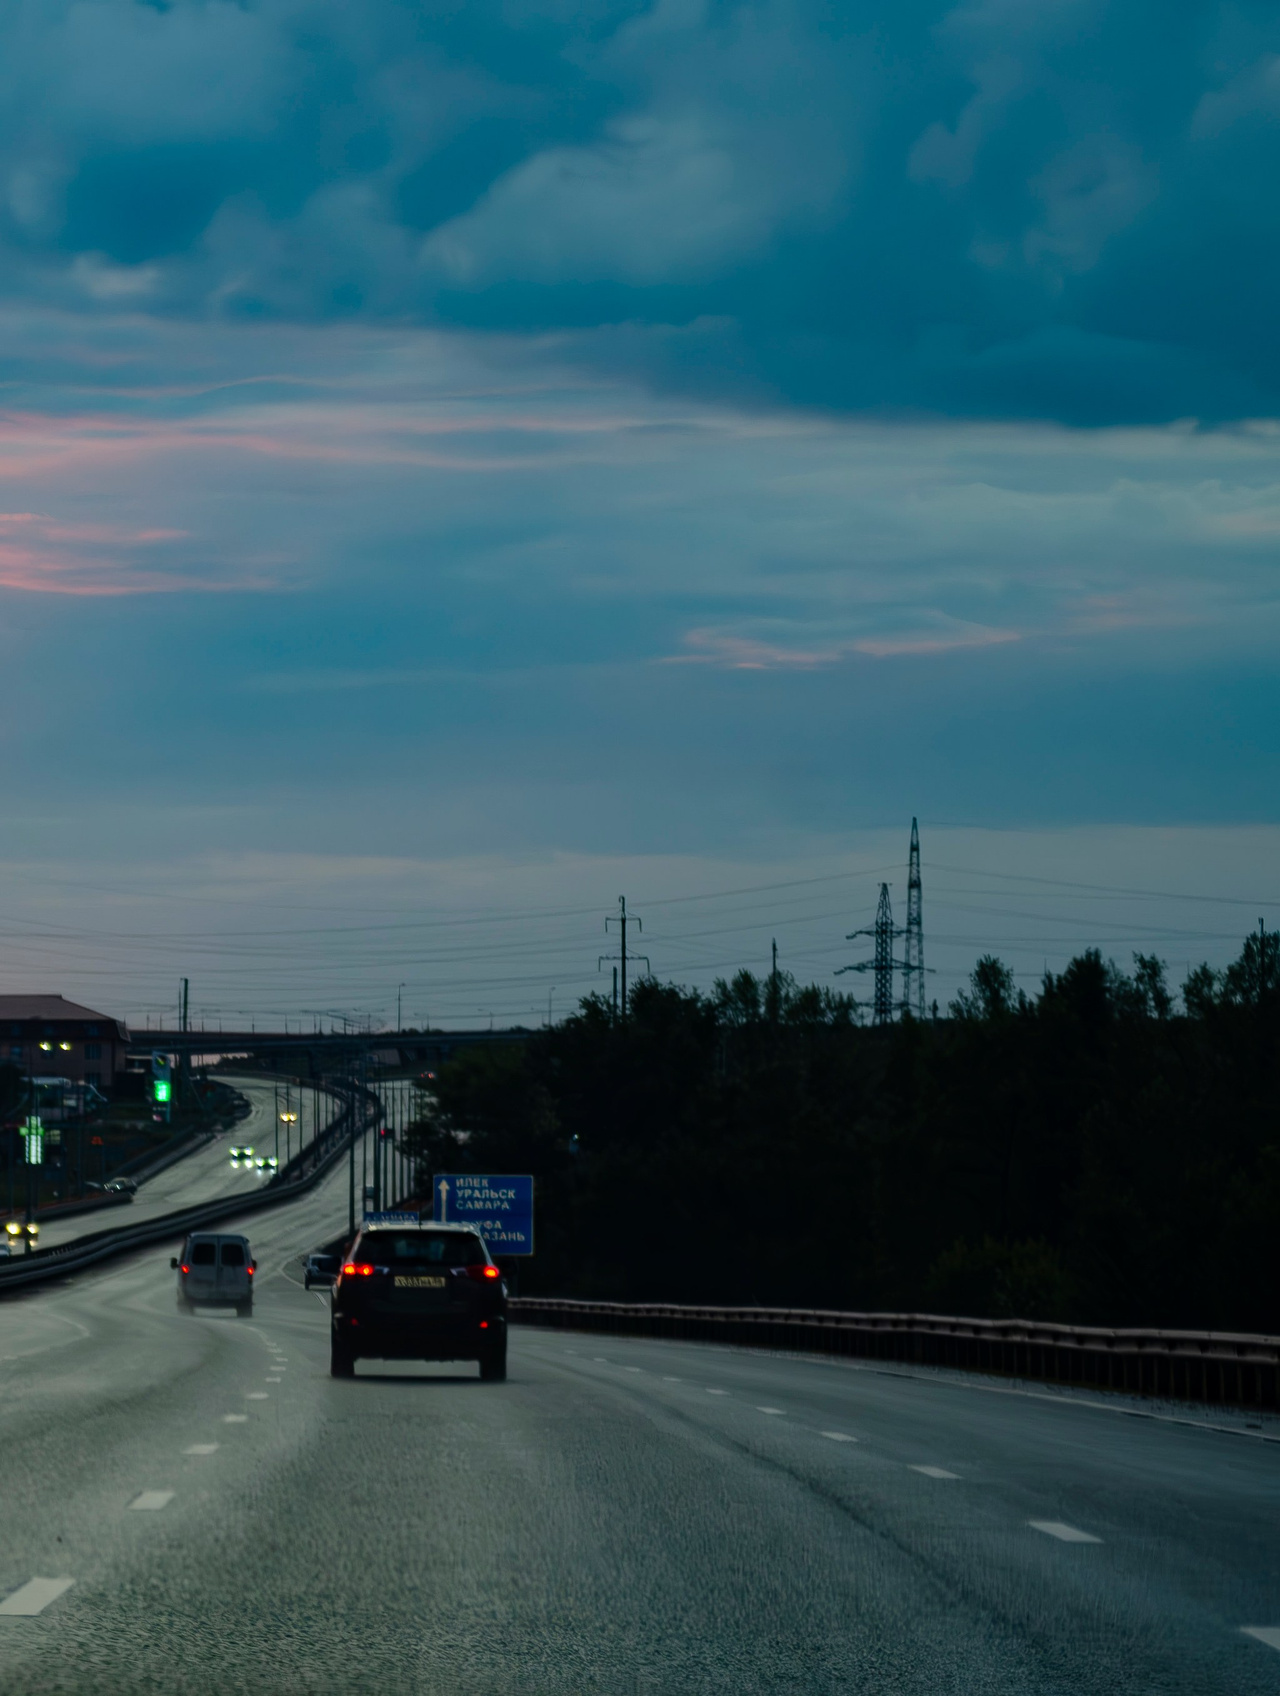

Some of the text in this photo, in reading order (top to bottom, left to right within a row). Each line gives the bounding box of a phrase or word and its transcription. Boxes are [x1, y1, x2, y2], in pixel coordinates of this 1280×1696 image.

[455, 1177, 489, 1188] ИЛЕК
[455, 1188, 516, 1199] УРАЛЬСК
[455, 1200, 510, 1210] САМАРА
[481, 1231, 526, 1242] АЗАНЬ
